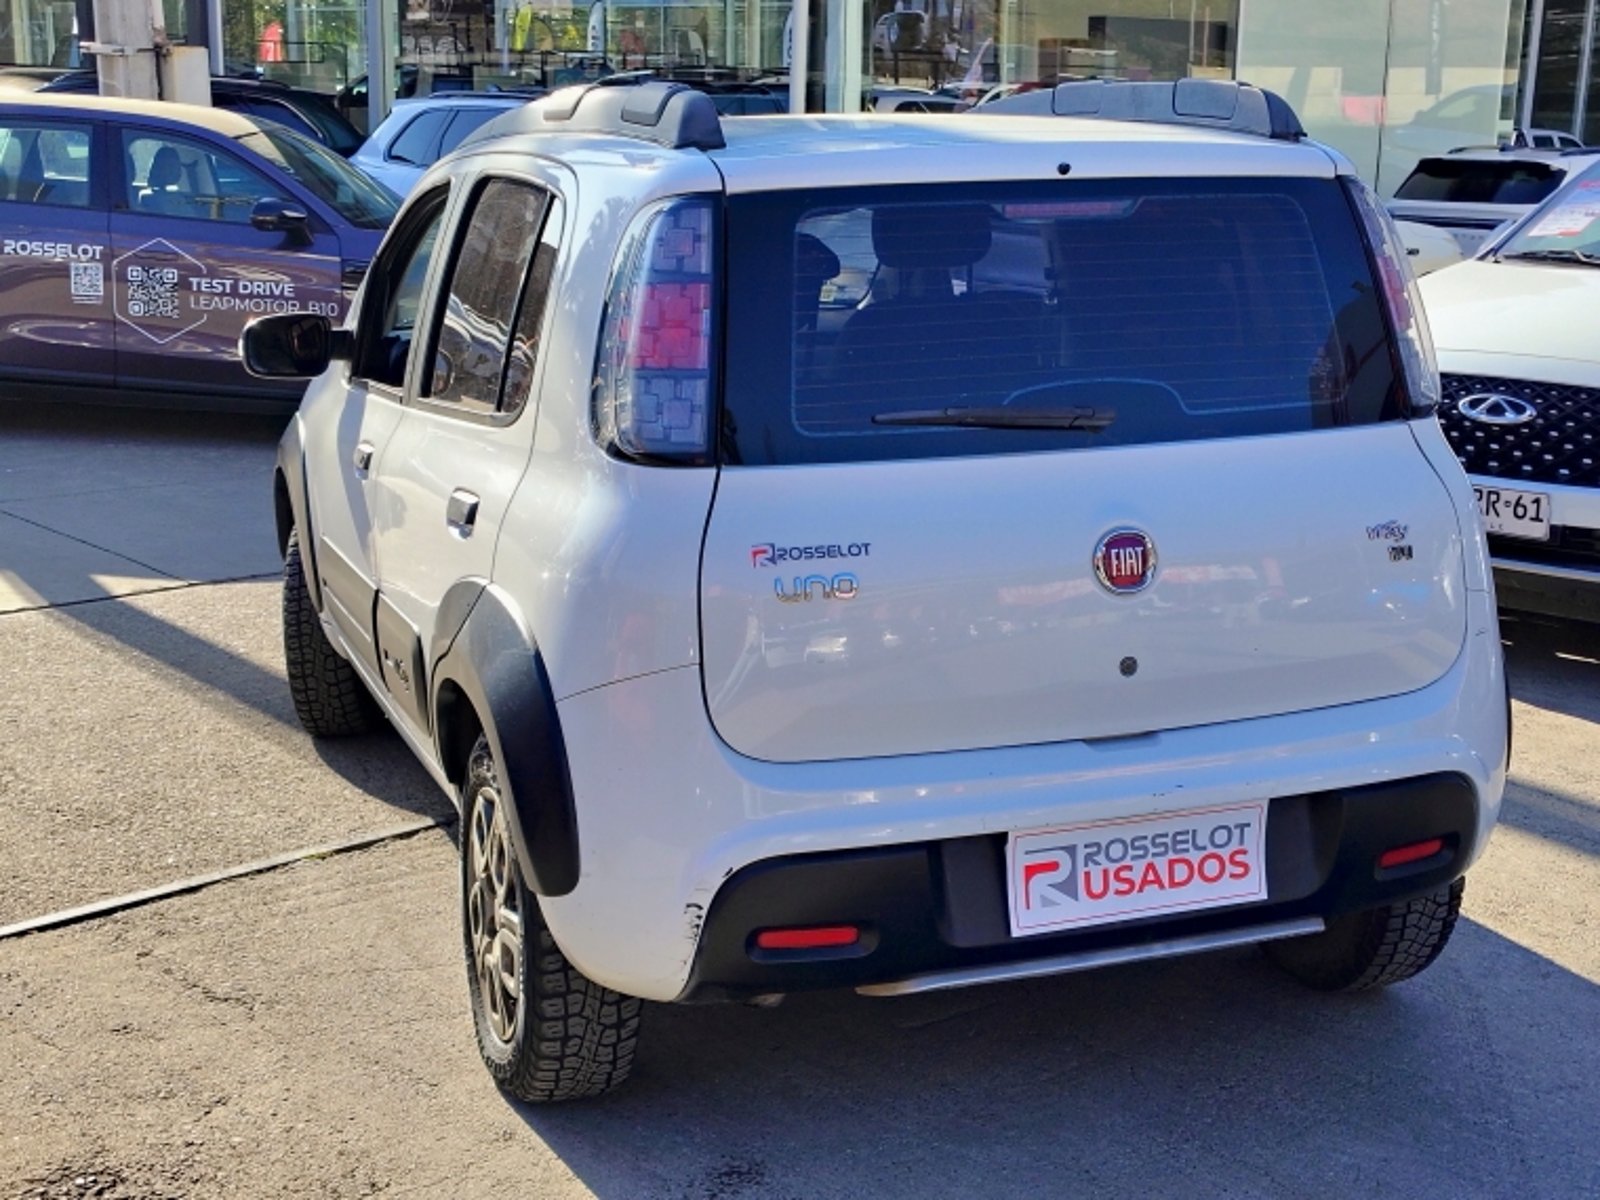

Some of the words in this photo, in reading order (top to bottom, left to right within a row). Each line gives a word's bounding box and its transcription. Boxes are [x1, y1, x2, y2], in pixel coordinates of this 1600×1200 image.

[3, 239, 104, 259] ROSSELOT
[188, 277, 234, 293] TEST
[238, 281, 295, 297] DRIVE
[190, 295, 300, 313] LEAPMOTOR
[308, 301, 339, 317] B10
[776, 542, 871, 561] ROSSELOT
[1111, 546, 1144, 577] FIAT
[1083, 822, 1252, 867] ROSSELOT
[1083, 849, 1251, 900] USADOS
